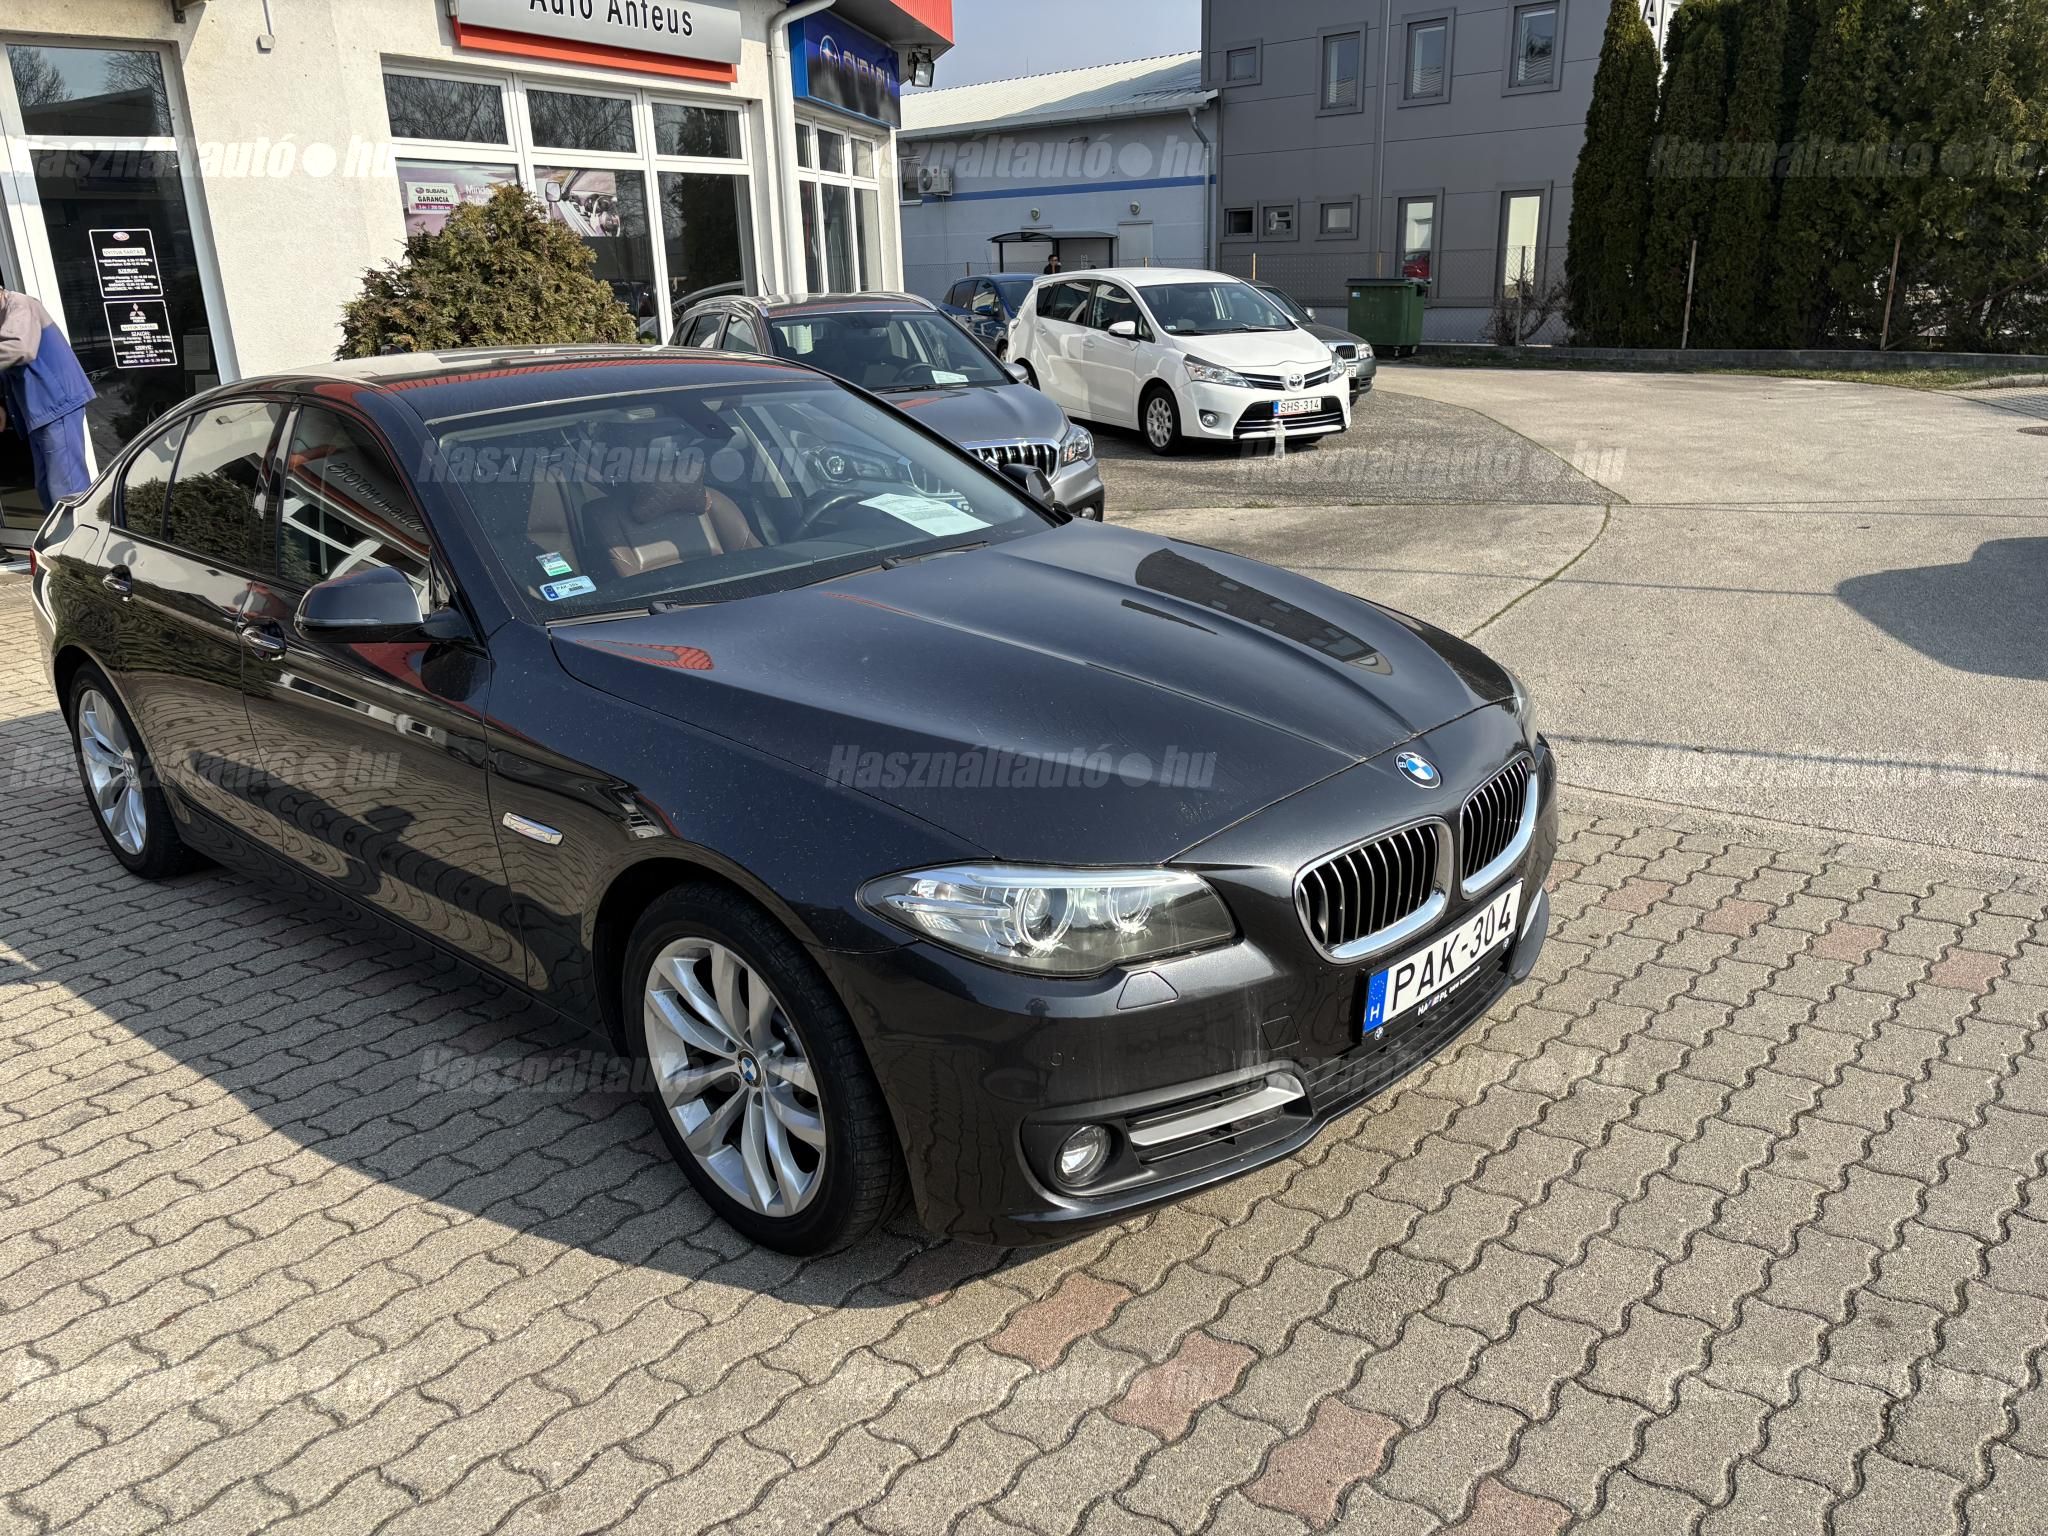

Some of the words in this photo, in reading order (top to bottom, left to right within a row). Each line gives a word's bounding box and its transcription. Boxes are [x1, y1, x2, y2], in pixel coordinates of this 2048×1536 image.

[607, 0, 693, 37] Anteus
[1280, 399, 1319, 413] SHS-314
[1369, 1004, 1380, 1021] H
[1391, 892, 1511, 1011] PAK-304
